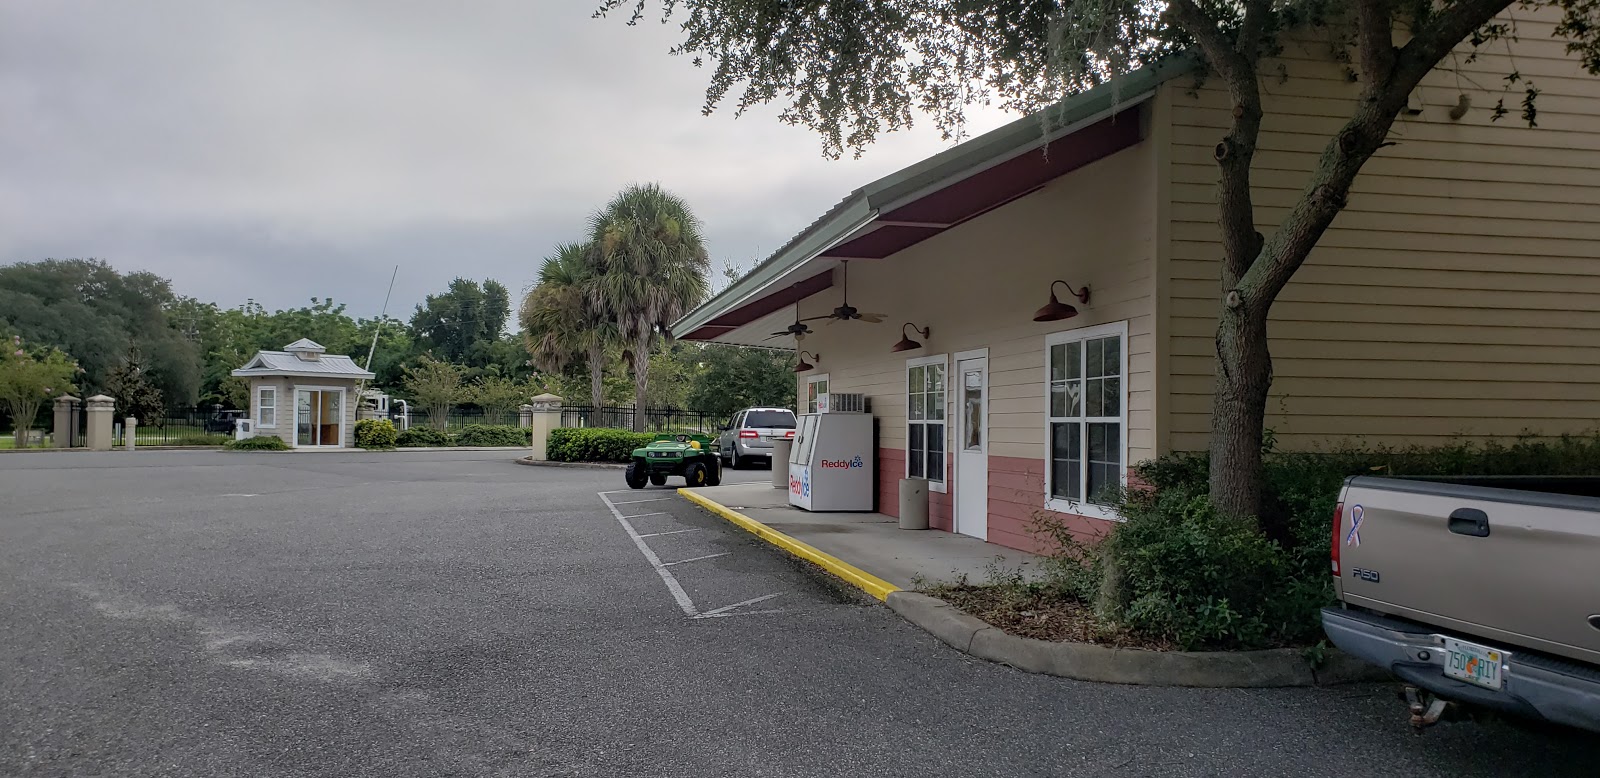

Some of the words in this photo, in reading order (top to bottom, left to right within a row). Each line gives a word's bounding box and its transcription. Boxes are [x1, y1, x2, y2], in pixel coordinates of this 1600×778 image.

[821, 459, 863, 470] ReddyIce
[1352, 567, 1380, 583] F150
[1448, 650, 1466, 671] 750
[1478, 658, 1497, 680] RIY
